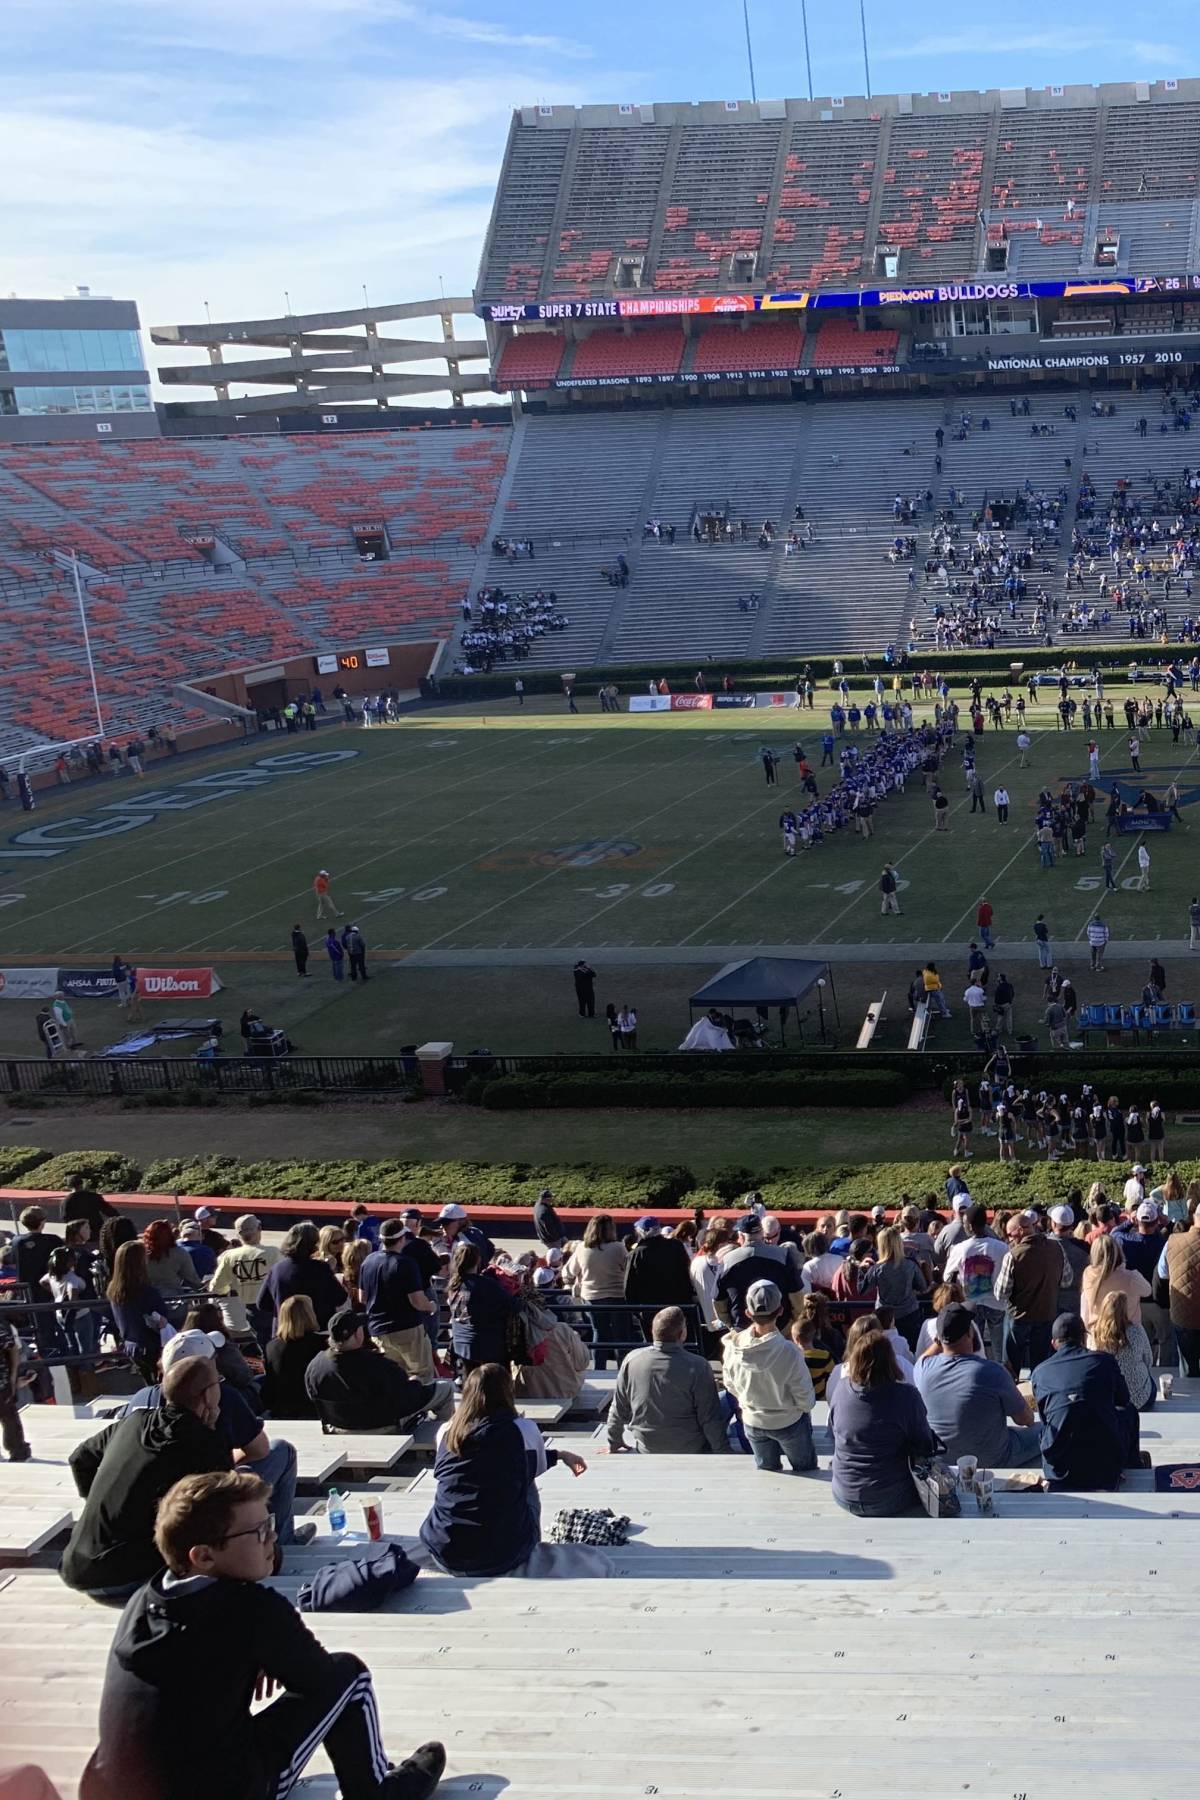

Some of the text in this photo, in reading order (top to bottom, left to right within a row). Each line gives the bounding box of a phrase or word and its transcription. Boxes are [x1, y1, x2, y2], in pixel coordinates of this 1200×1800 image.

[1165, 277, 1180, 290] 26
[879, 283, 1019, 302] PIEDMONT BULLDOGS
[539, 298, 700, 319] SUPER 7 STATE CHAMPIONSHIPS
[988, 352, 1182, 370] NATIONAL CHAMPIONS 1957 2010
[556, 379, 598, 388] UNDEFEATED
[883, 365, 900, 374] 2010
[341, 655, 358, 669] 40
[154, 890, 231, 906] 10
[364, 886, 449, 903] 20
[595, 882, 677, 900] 30
[144, 976, 199, 992] Wilson
